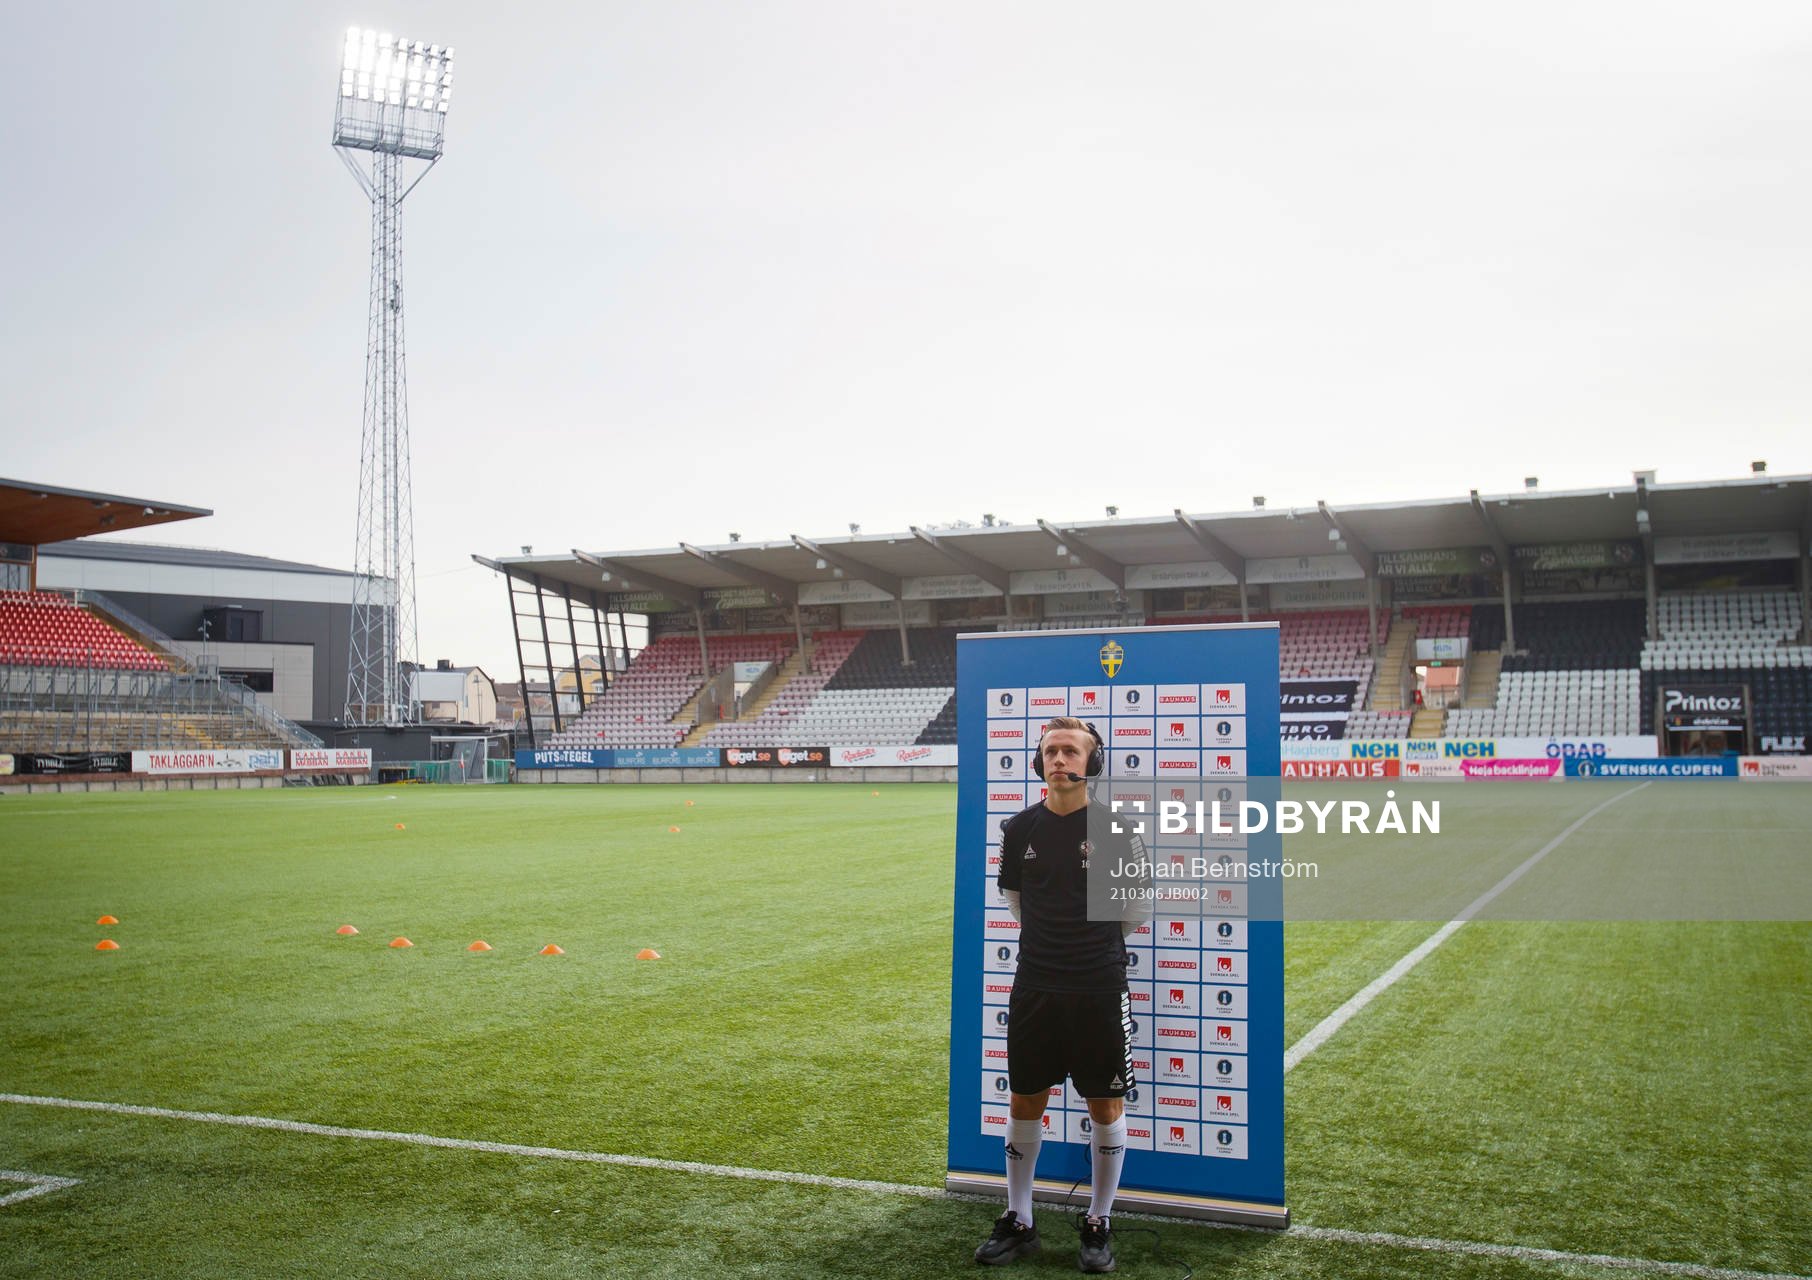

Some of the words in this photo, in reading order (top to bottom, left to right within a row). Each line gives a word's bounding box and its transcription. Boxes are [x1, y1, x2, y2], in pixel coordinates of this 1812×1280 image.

[1281, 693, 1348, 704] intoz
[1665, 690, 1742, 712] Printoz
[1280, 724, 1329, 734] EBRO
[1284, 763, 1386, 778] AUHAUS
[1600, 764, 1668, 776] SVENSKA
[1671, 764, 1723, 775] CUPEN
[985, 1050, 1008, 1058] BAUHA
[984, 1116, 1007, 1124] BAUHA
[1128, 1129, 1150, 1137] HAUS
